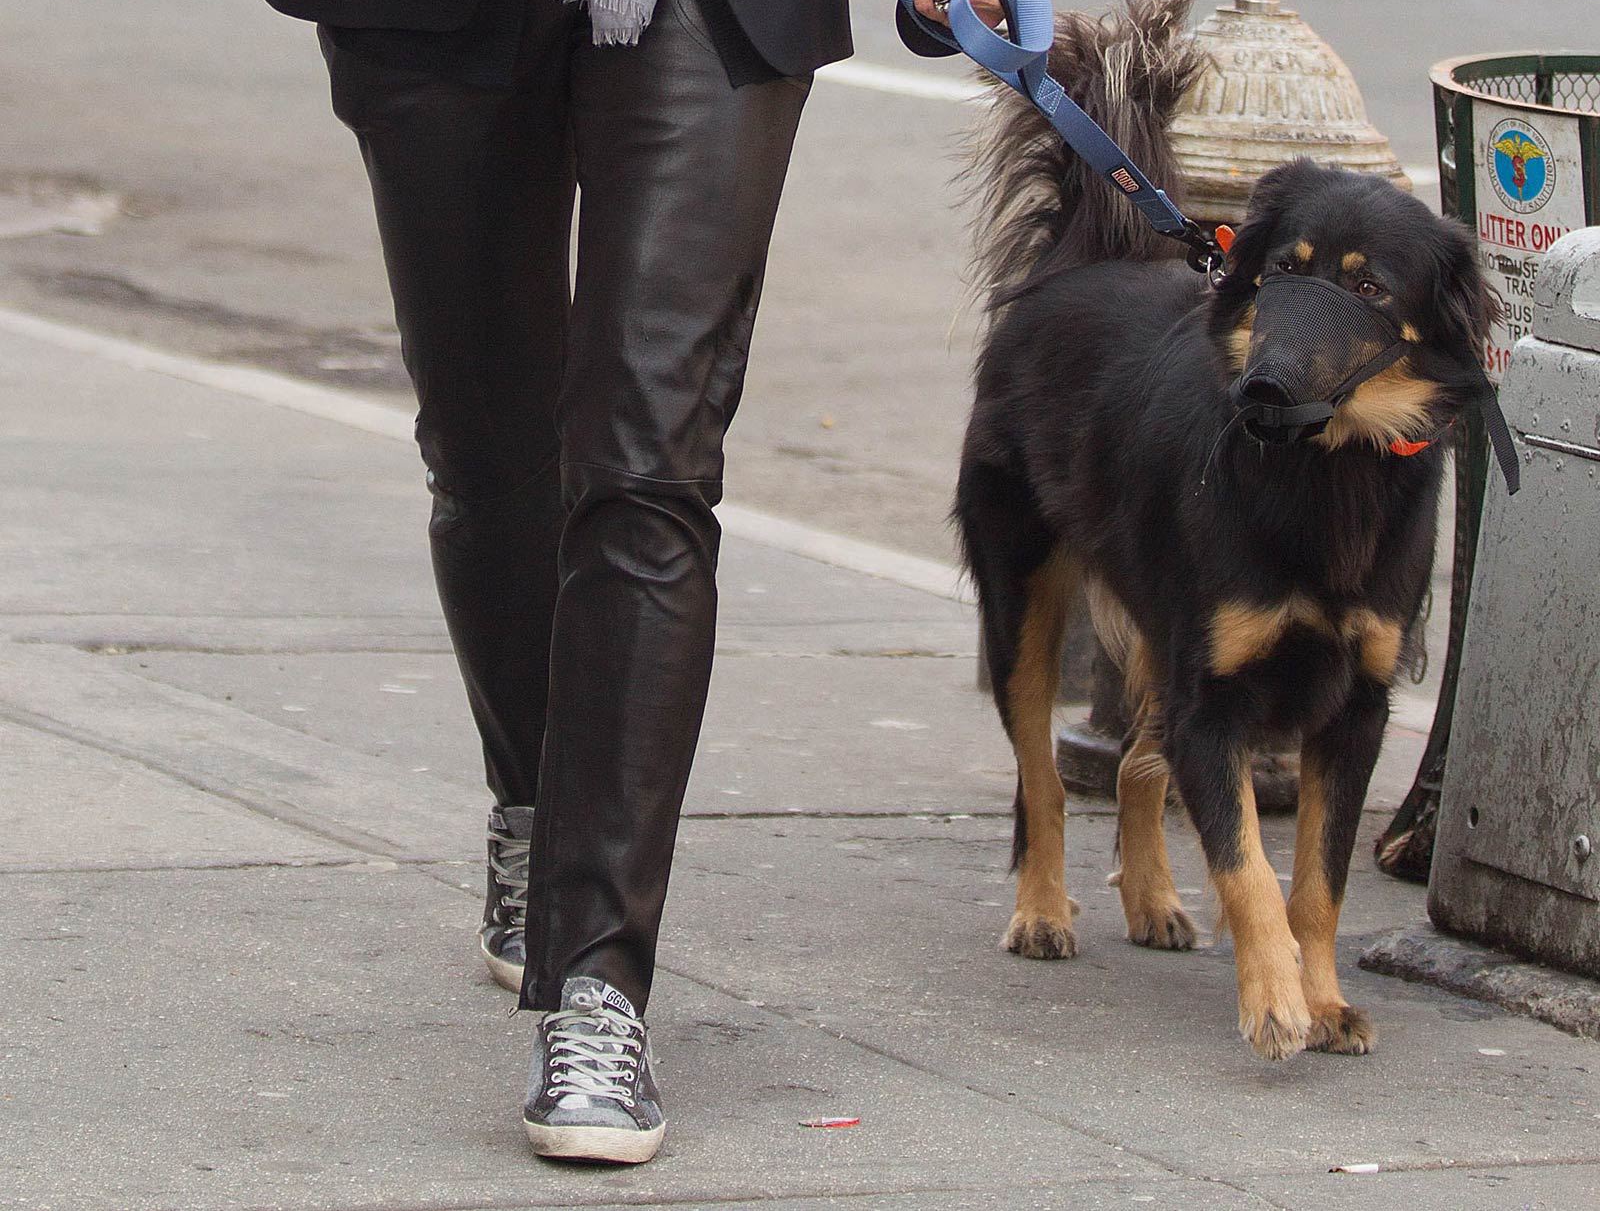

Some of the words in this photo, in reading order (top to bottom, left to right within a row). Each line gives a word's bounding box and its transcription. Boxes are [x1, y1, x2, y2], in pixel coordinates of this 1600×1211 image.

[1111, 168, 1139, 192] KONG
[1488, 148, 1517, 210] DEPARTMENT
[1528, 155, 1554, 210] SANITATION
[1478, 211, 1527, 248] LITTER
[606, 990, 631, 1013] GGDB
